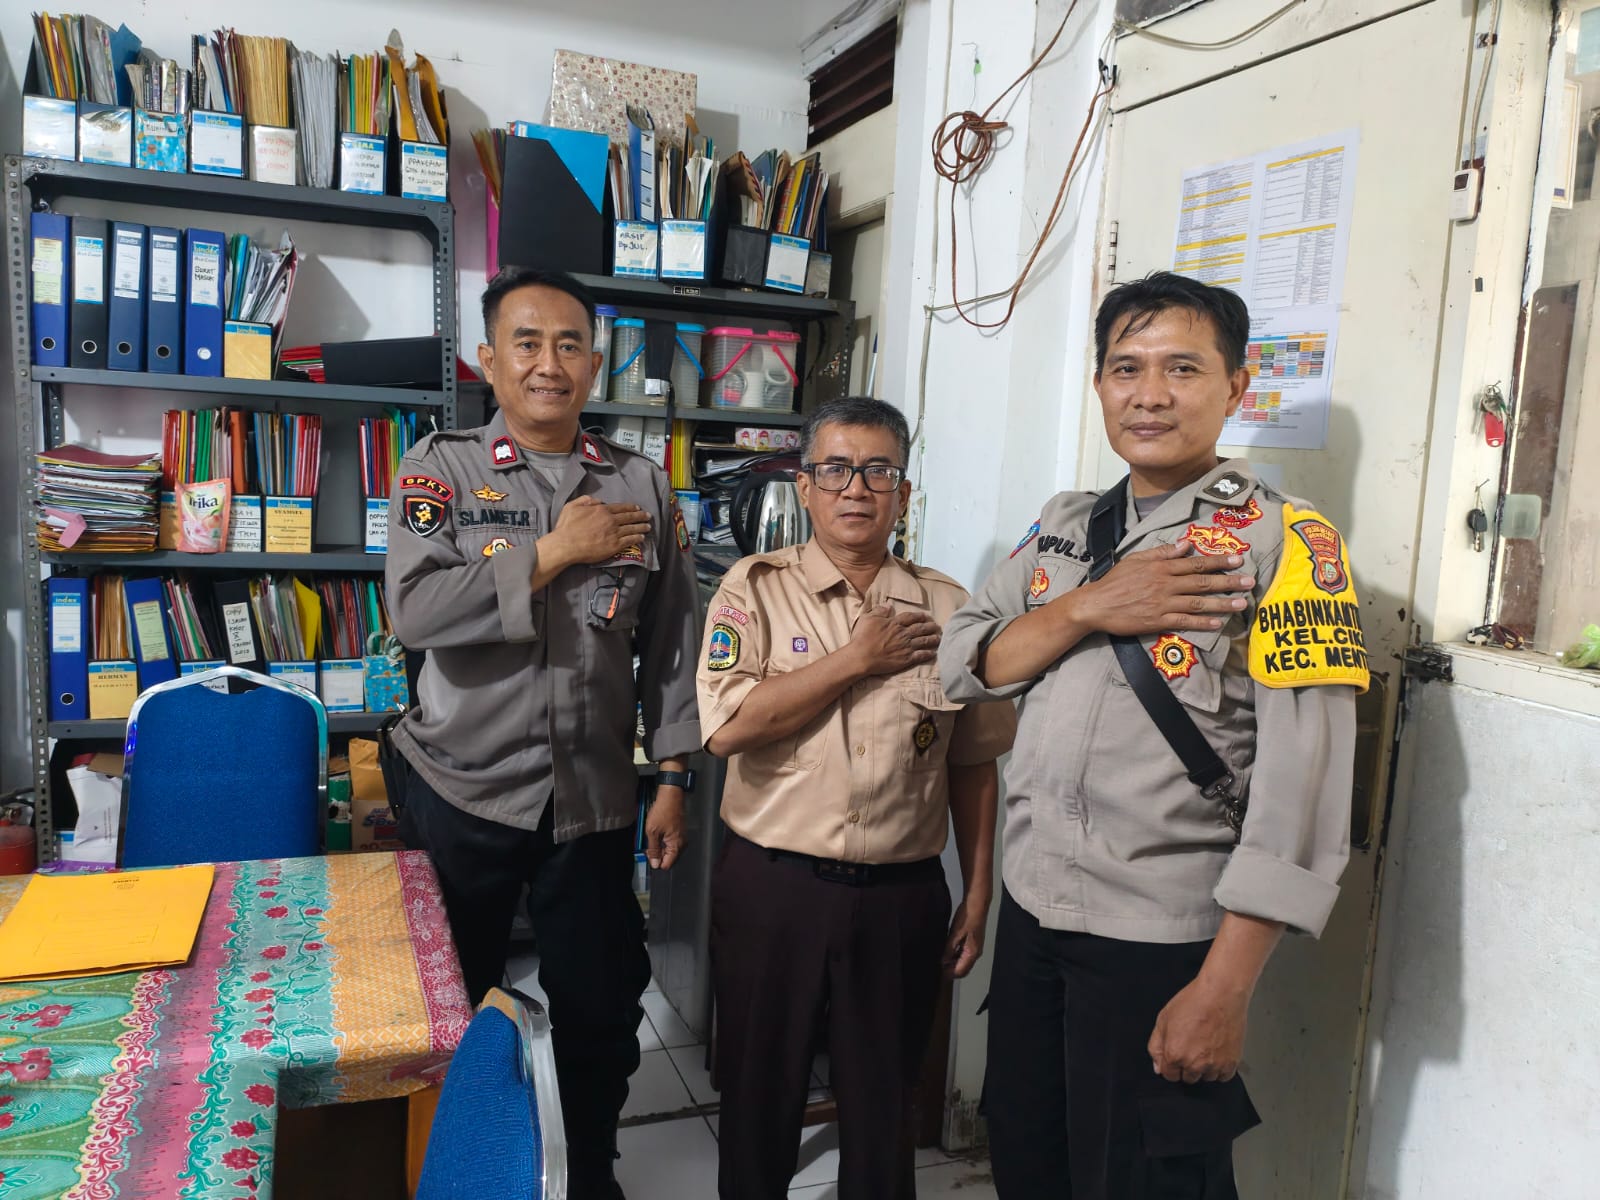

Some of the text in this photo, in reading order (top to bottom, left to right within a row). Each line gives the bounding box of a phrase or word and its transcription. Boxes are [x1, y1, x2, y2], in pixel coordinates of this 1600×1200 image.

[458, 509, 530, 527] SLAMET.R
[1265, 646, 1369, 674] KEC. MENT
